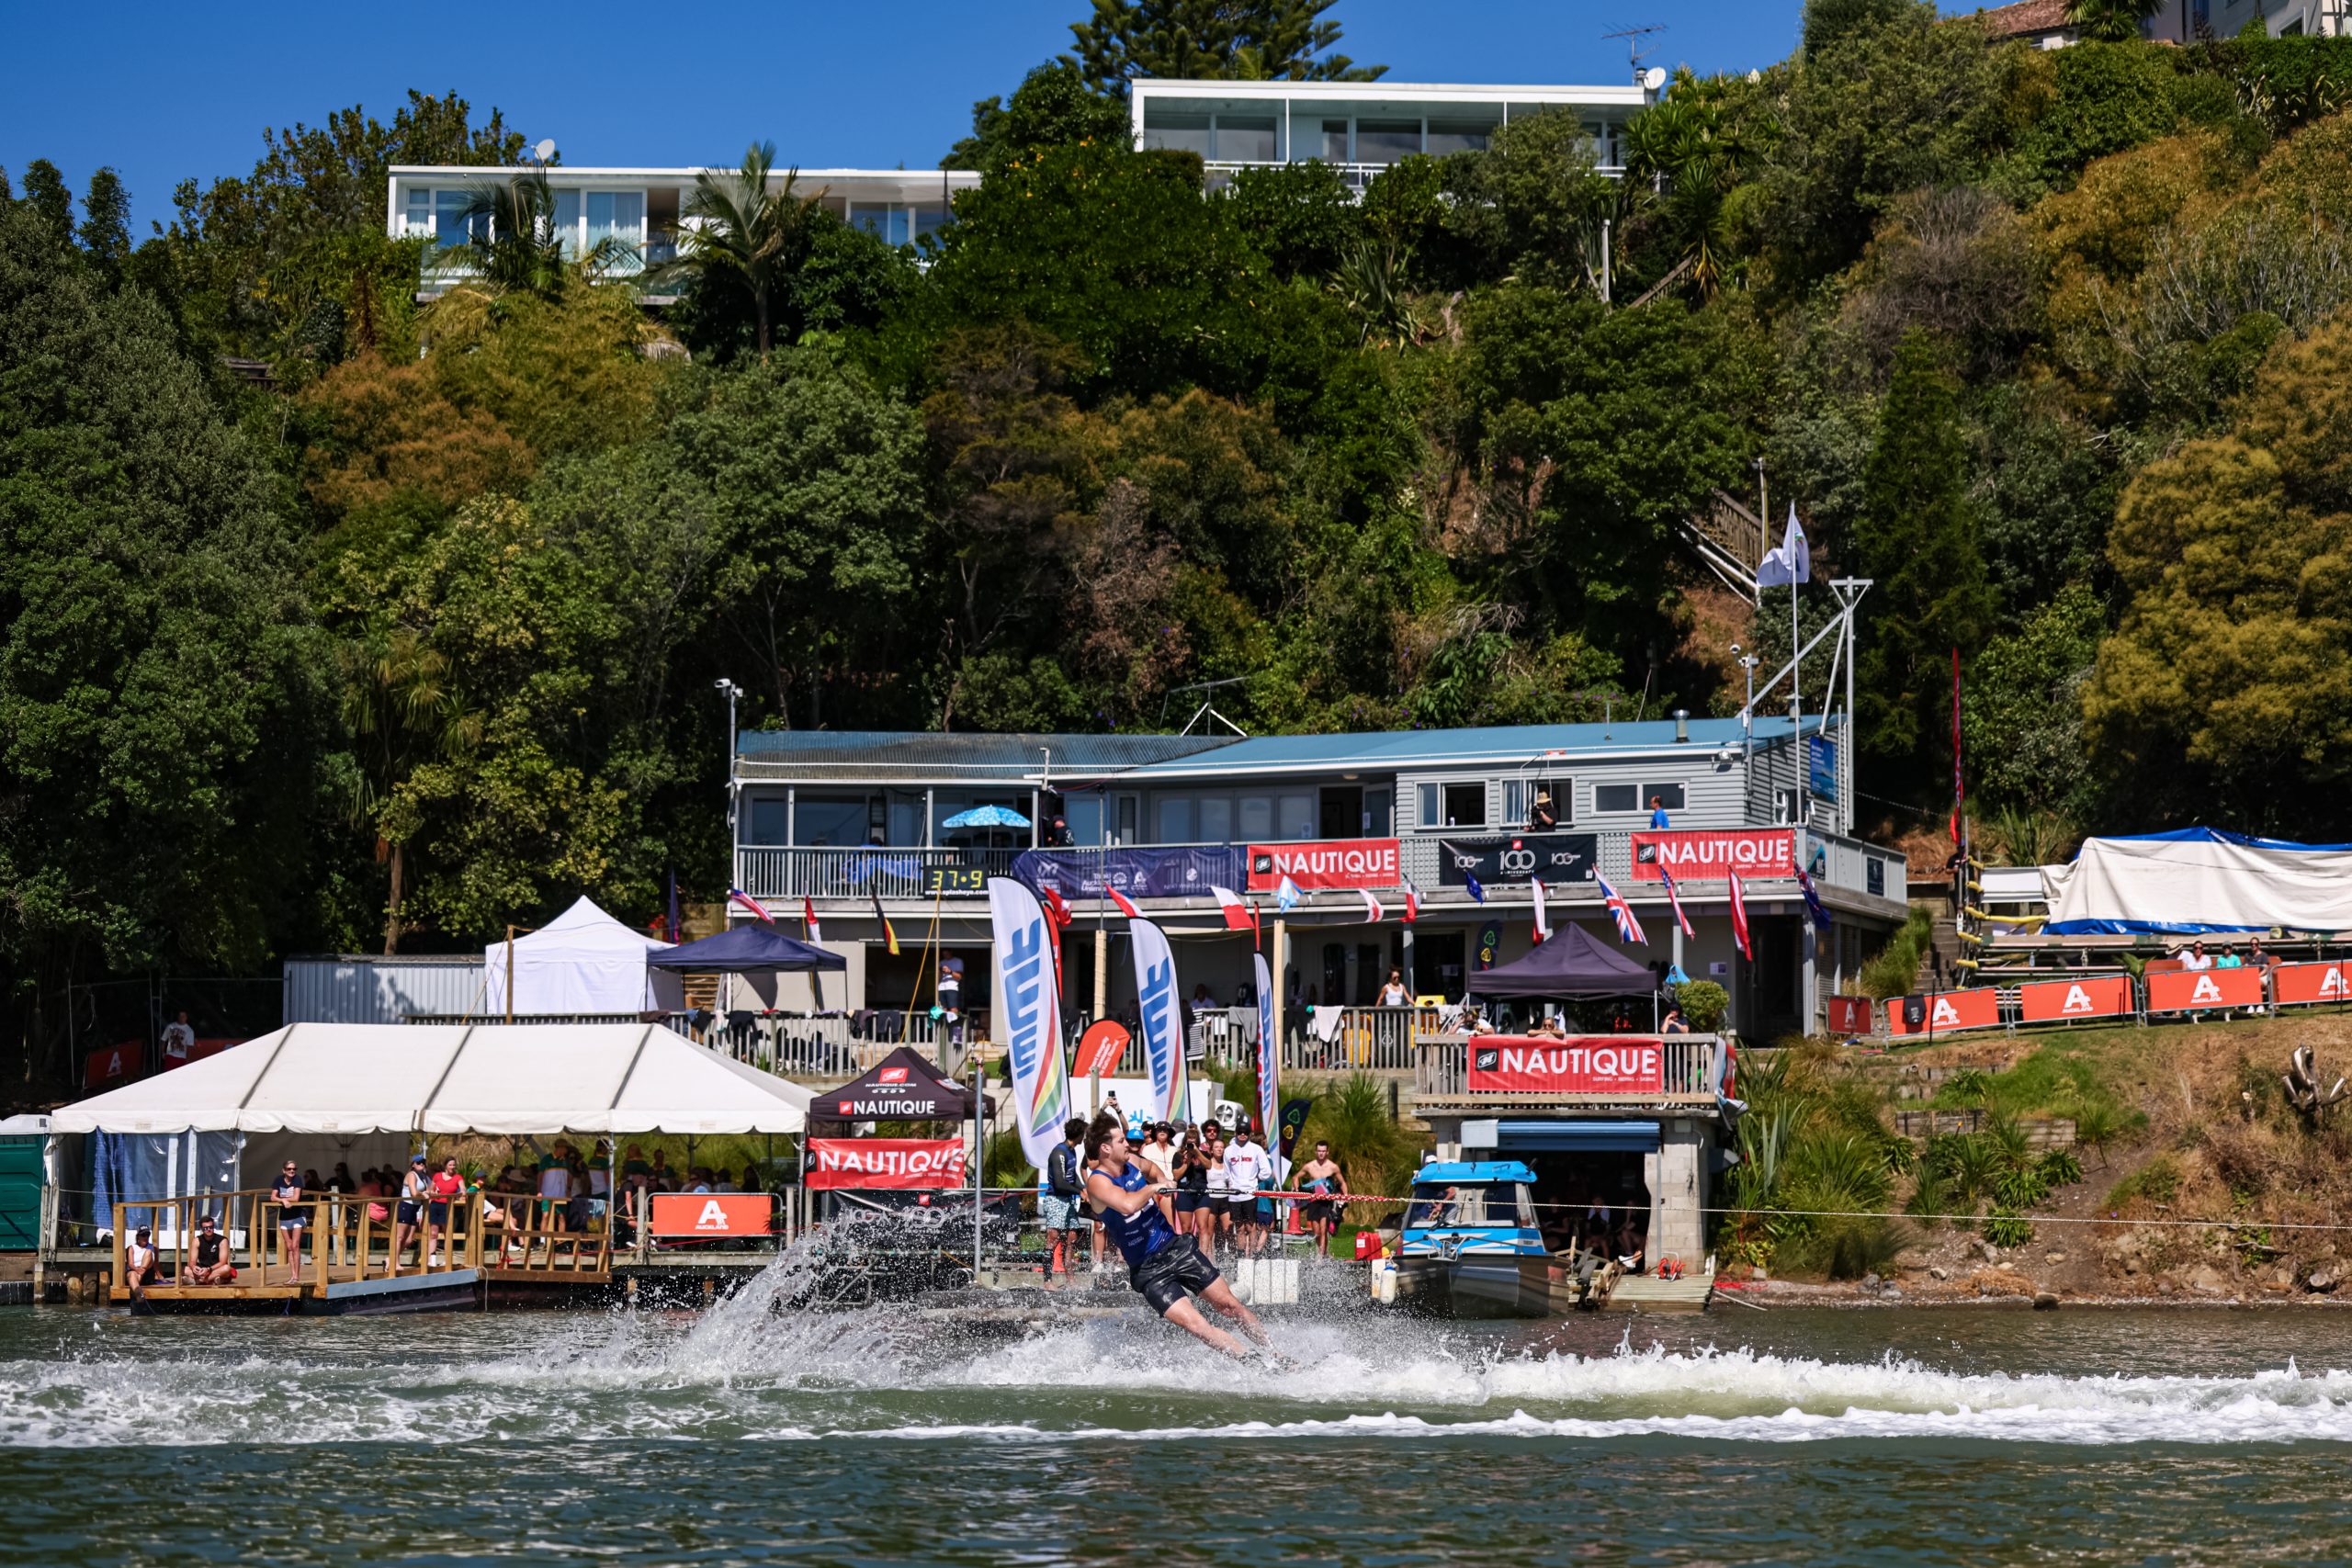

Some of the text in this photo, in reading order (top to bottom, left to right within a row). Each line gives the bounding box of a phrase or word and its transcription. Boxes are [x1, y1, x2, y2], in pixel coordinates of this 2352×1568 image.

[1274, 849, 1395, 874] NAUTIQUE
[1499, 850, 1535, 870] 100
[1658, 839, 1789, 864] NAUTIQUE
[2062, 1006, 2094, 1014] AUCKLAND
[1502, 1048, 1657, 1076] NAUTIQUE
[854, 1100, 935, 1115] NAUTIQUE
[820, 1148, 964, 1176] NAUTIQUE
